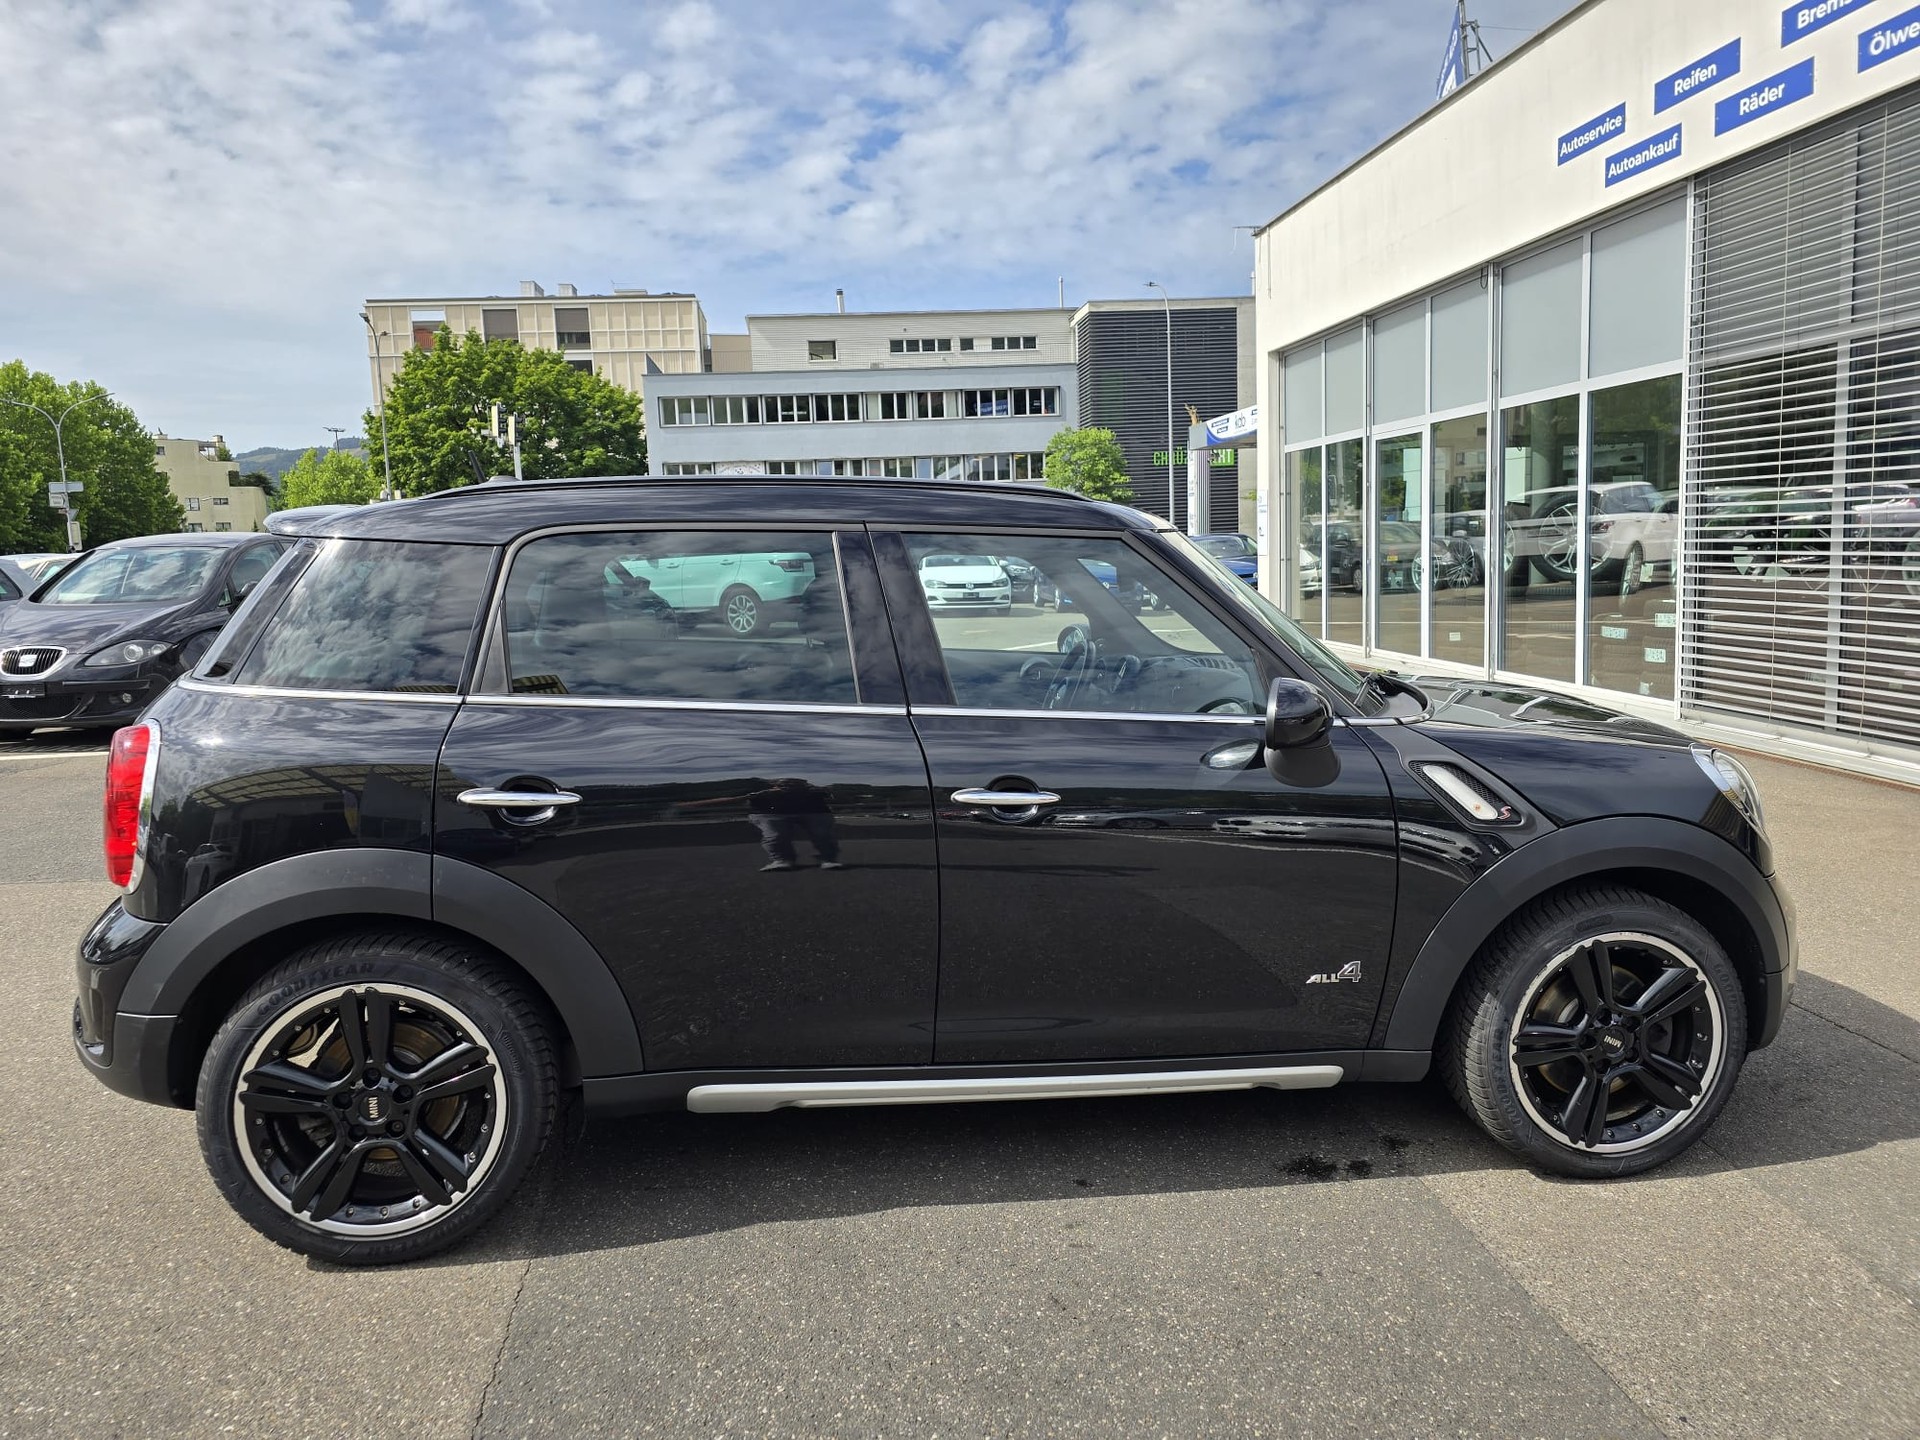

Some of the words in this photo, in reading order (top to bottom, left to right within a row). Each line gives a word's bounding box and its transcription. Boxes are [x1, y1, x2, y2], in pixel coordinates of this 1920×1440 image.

[1674, 62, 1718, 96] Reifen
[1739, 82, 1785, 115] Räder
[1559, 115, 1622, 157] Autoservice
[1607, 132, 1679, 178] Autoankauf
[257, 962, 376, 1016] GOODYEAR
[1305, 960, 1361, 984] ALL4
[368, 1096, 379, 1118] MINI
